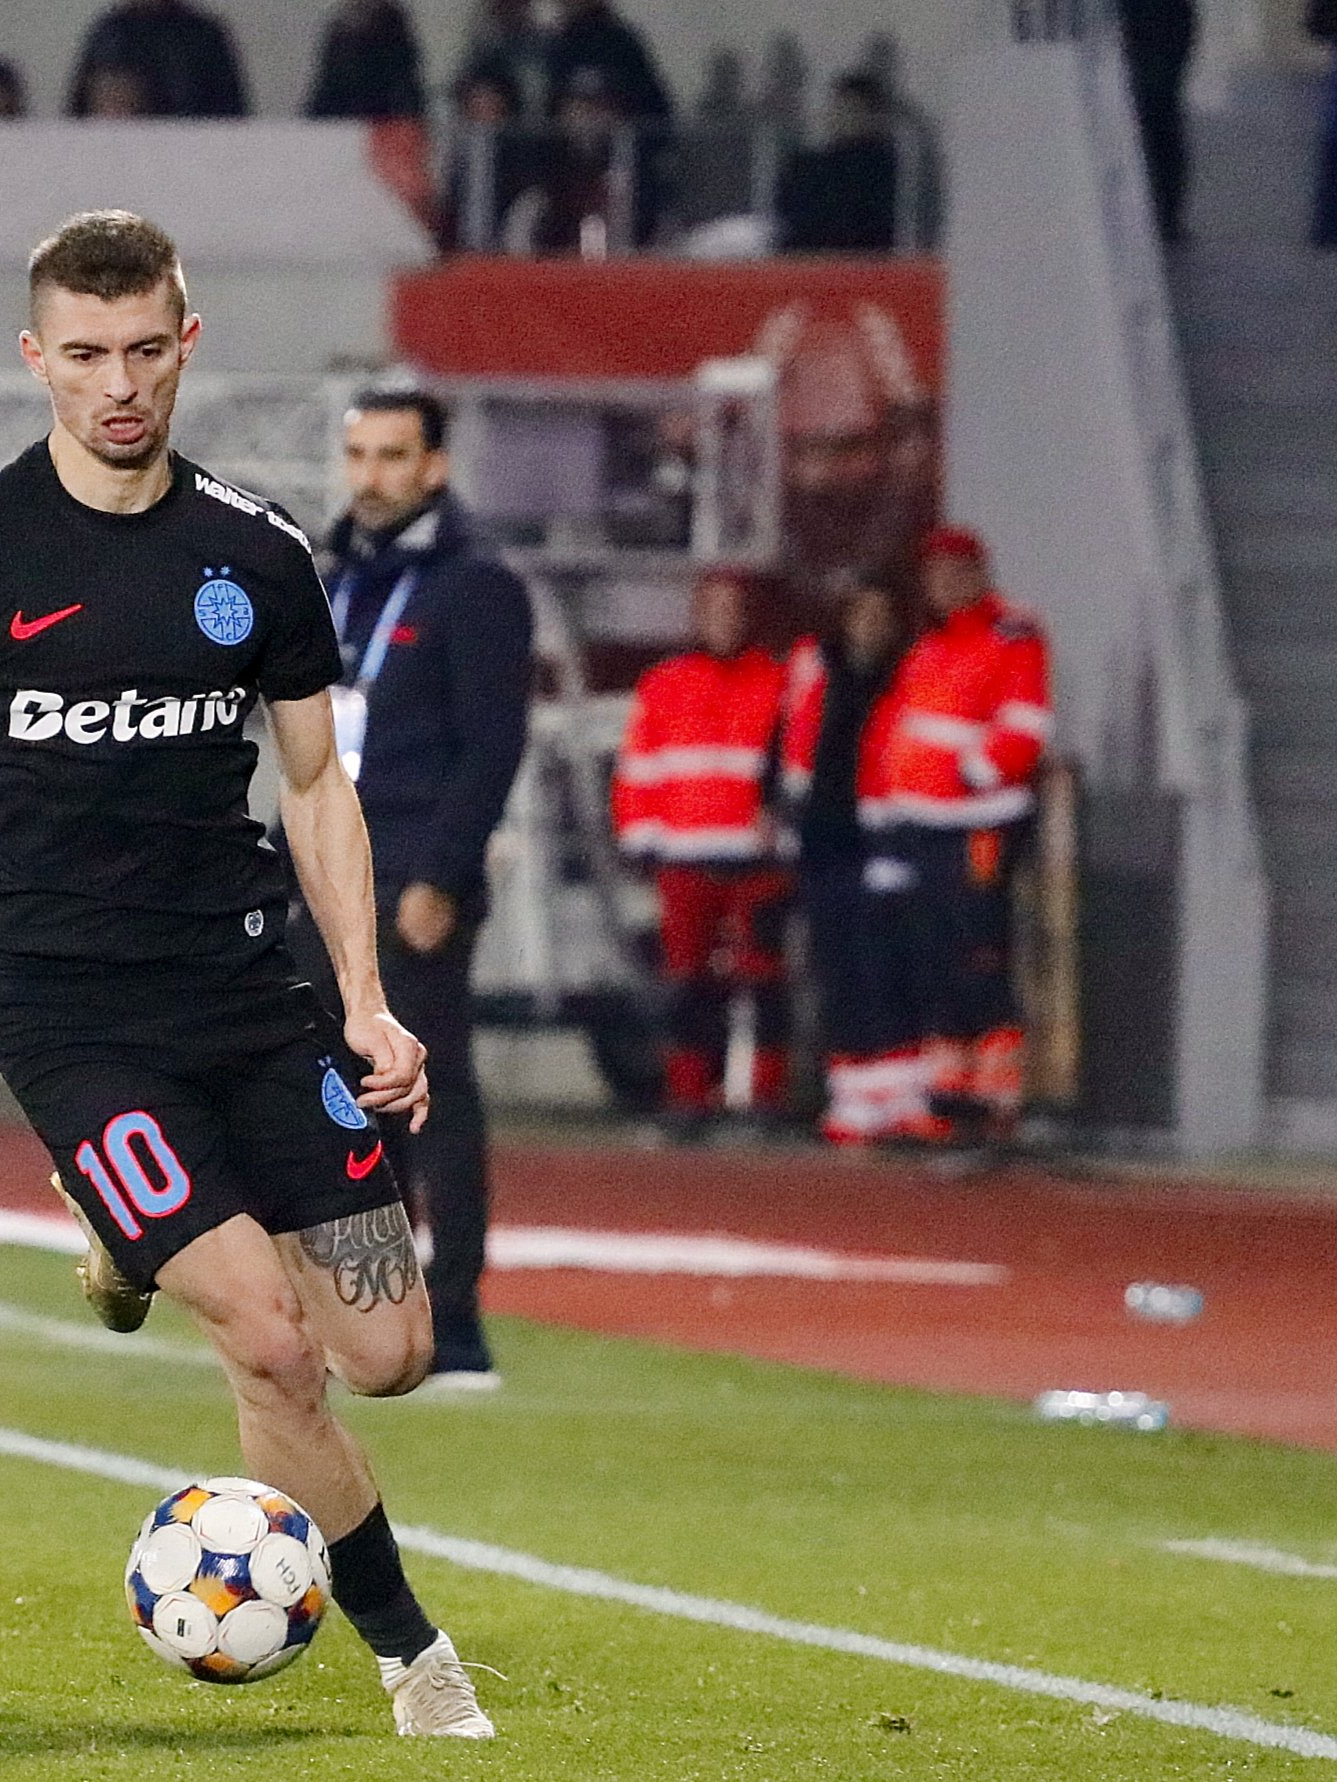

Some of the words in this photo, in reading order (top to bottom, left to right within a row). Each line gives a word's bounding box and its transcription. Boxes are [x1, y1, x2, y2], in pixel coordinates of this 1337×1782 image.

[194, 473, 265, 517] walter
[8, 688, 246, 745] Betano
[74, 1109, 192, 1241] 10
